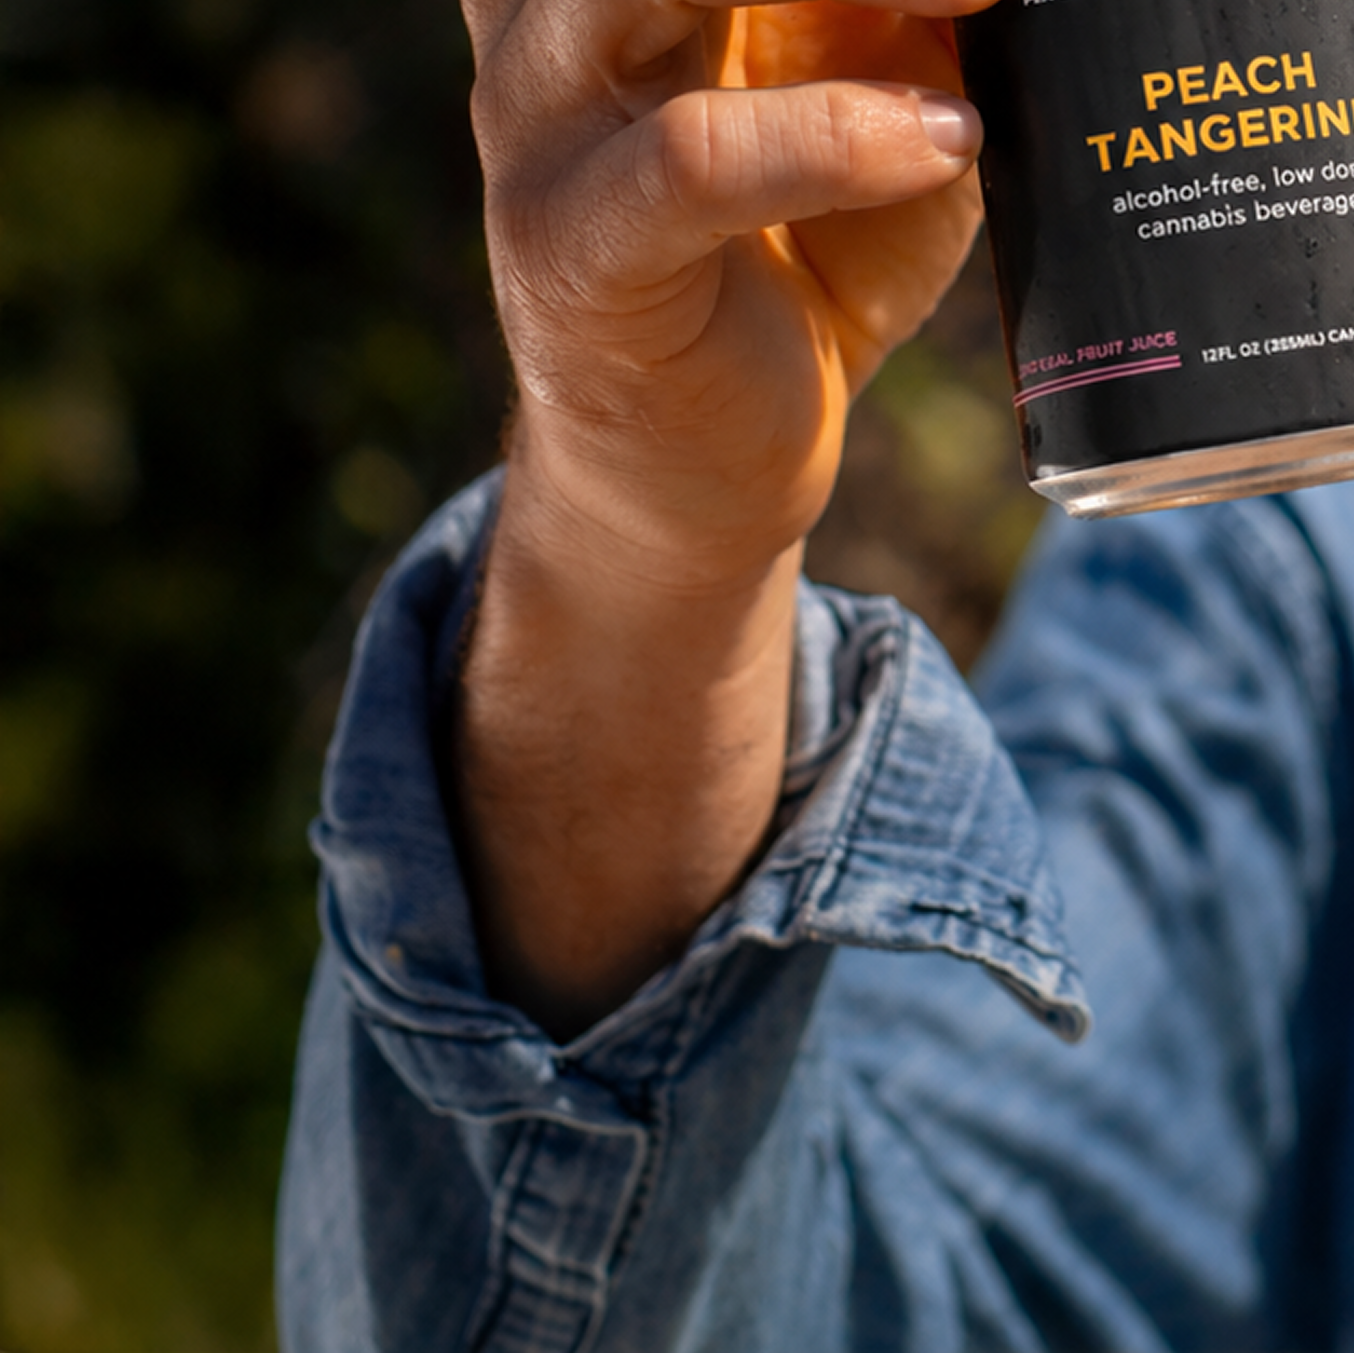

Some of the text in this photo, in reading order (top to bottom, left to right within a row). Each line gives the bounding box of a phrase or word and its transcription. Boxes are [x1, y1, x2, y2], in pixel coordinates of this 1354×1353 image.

[1142, 51, 1317, 111] PEACH
[1112, 172, 1267, 214] alcohol-free,
[1272, 165, 1315, 187] low
[1136, 203, 1248, 240] cannabis
[1127, 330, 1178, 353] JUICE
[1239, 342, 1262, 358] OZ
